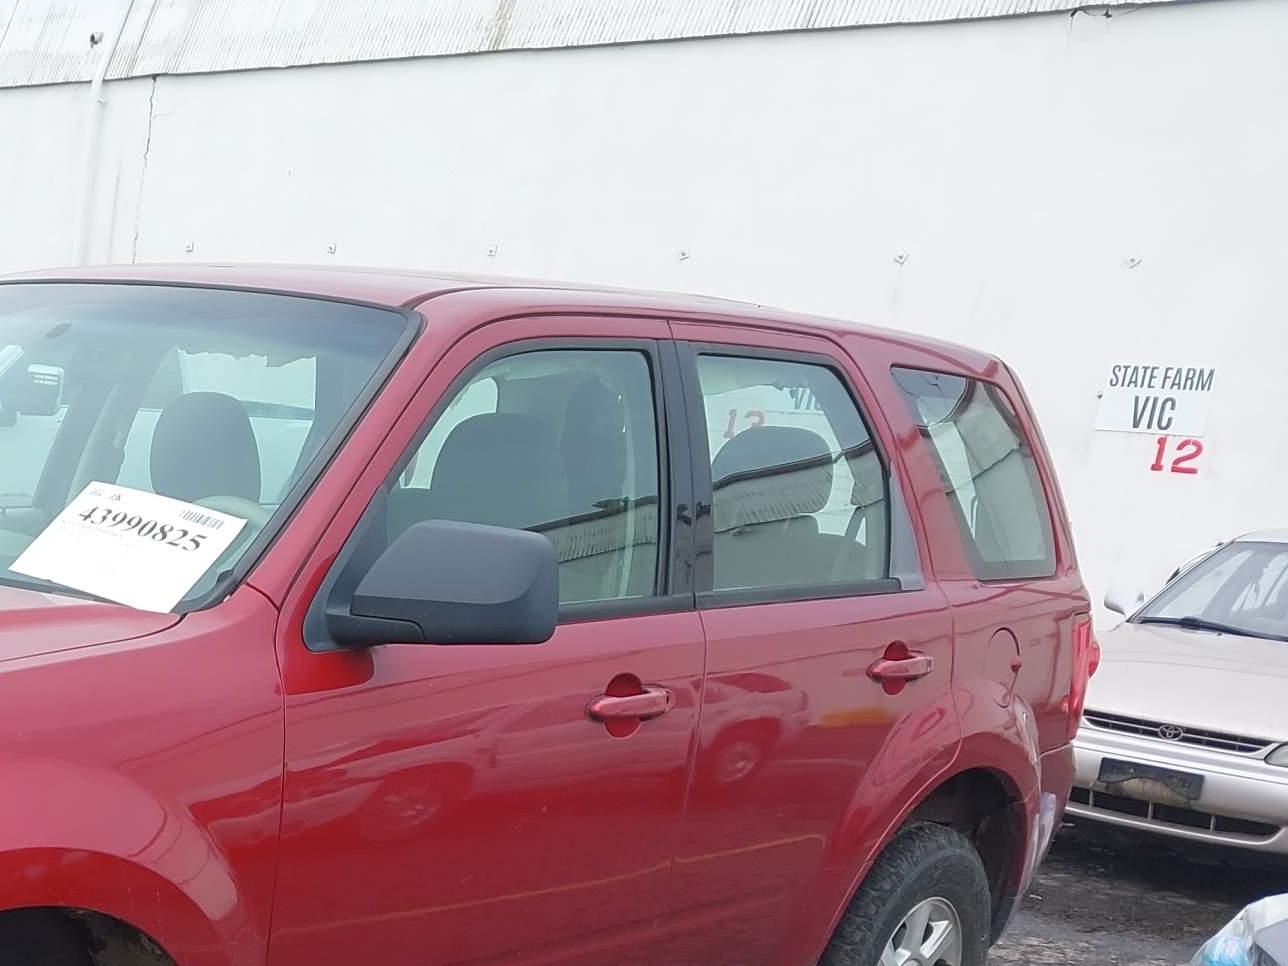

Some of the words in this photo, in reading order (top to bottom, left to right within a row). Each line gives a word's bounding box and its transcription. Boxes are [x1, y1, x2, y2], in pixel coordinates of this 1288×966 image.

[1109, 364, 1160, 389] STATE
[1161, 367, 1216, 392] FARM
[1132, 395, 1176, 431] VIC
[1150, 436, 1204, 474] 12
[78, 506, 208, 551] 43990825
